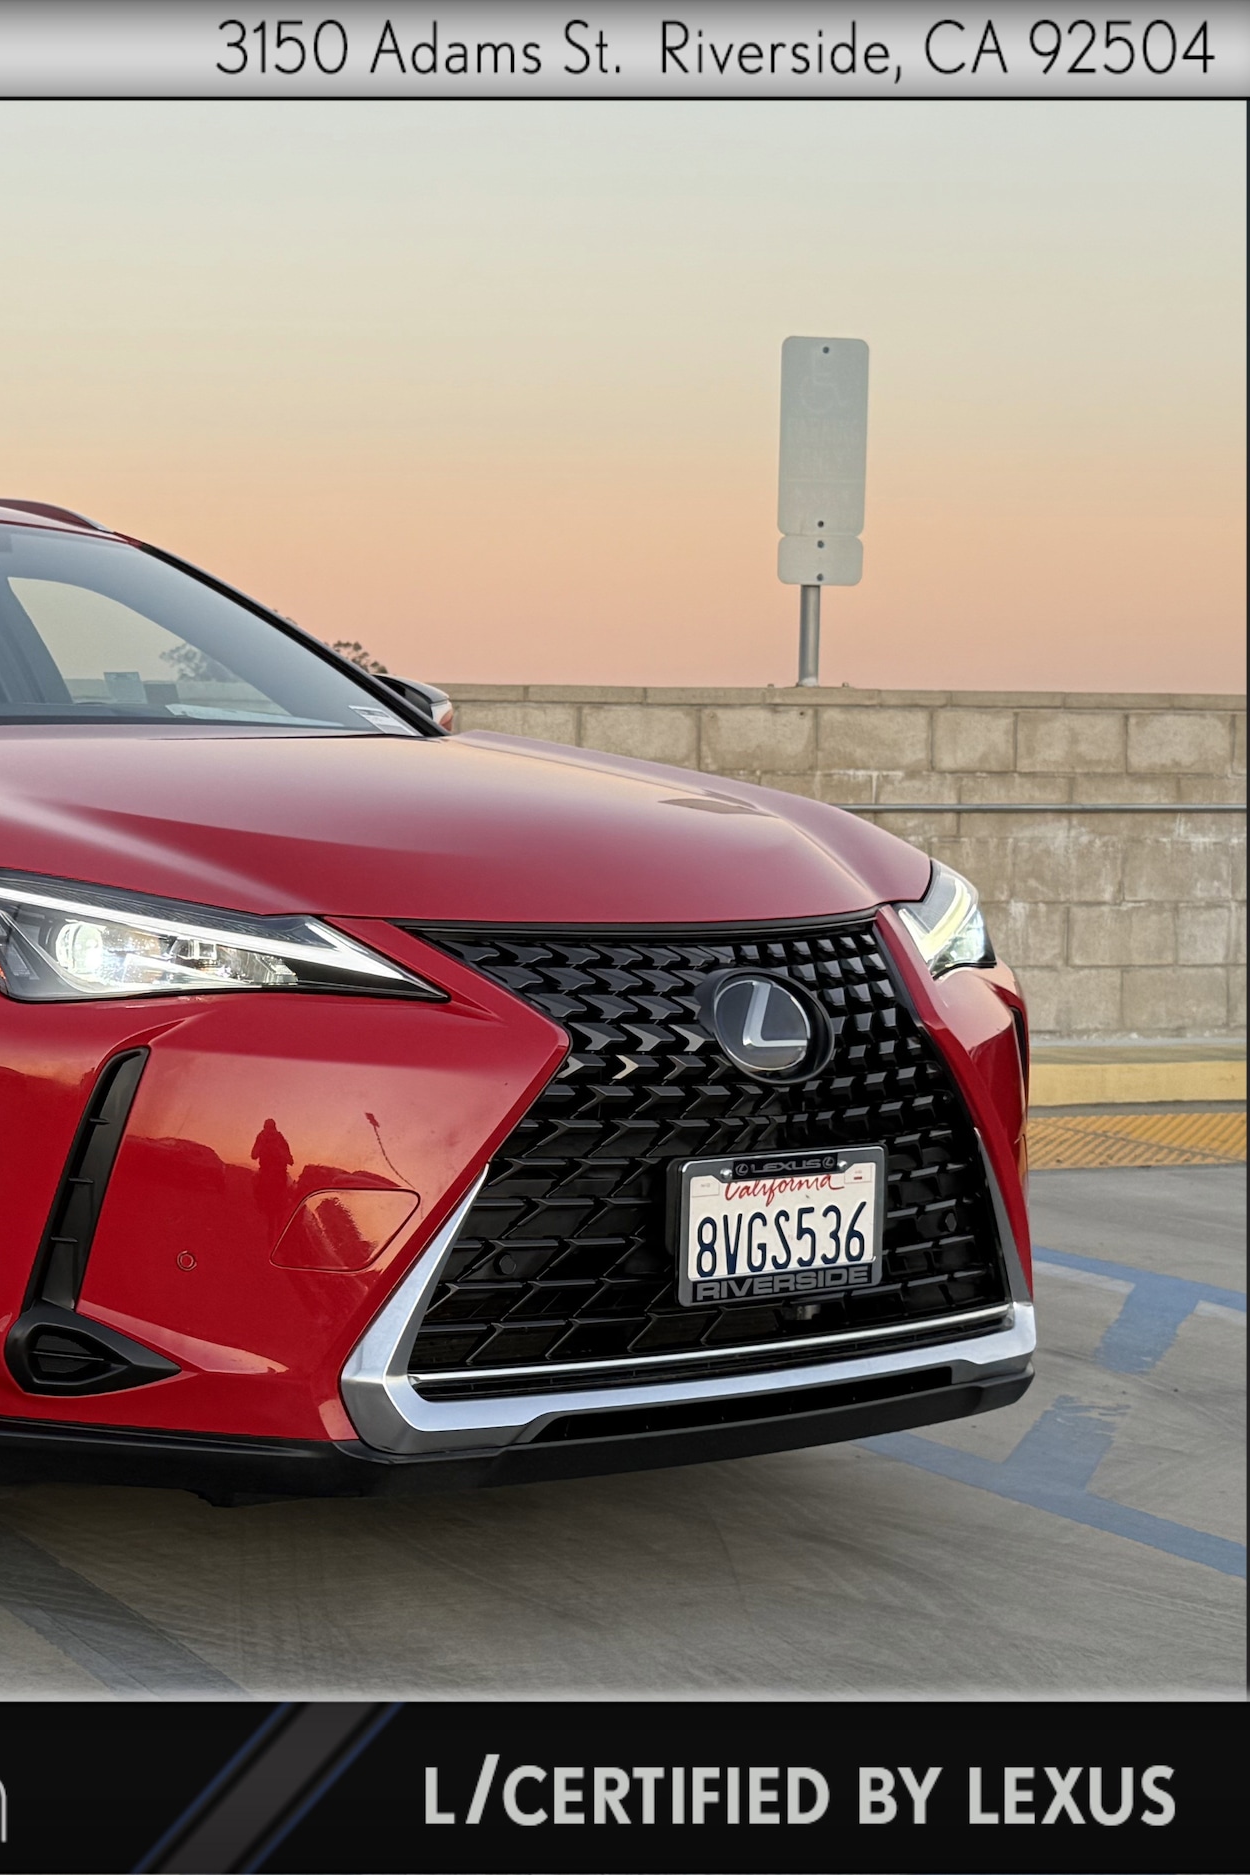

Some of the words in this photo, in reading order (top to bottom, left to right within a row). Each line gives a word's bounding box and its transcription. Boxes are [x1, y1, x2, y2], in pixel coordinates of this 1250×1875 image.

[750, 1158, 822, 1174] LEXUS
[724, 1174, 845, 1208] California
[696, 1200, 868, 1278] 8VGS536
[696, 1266, 868, 1301] RIVERSIDE
